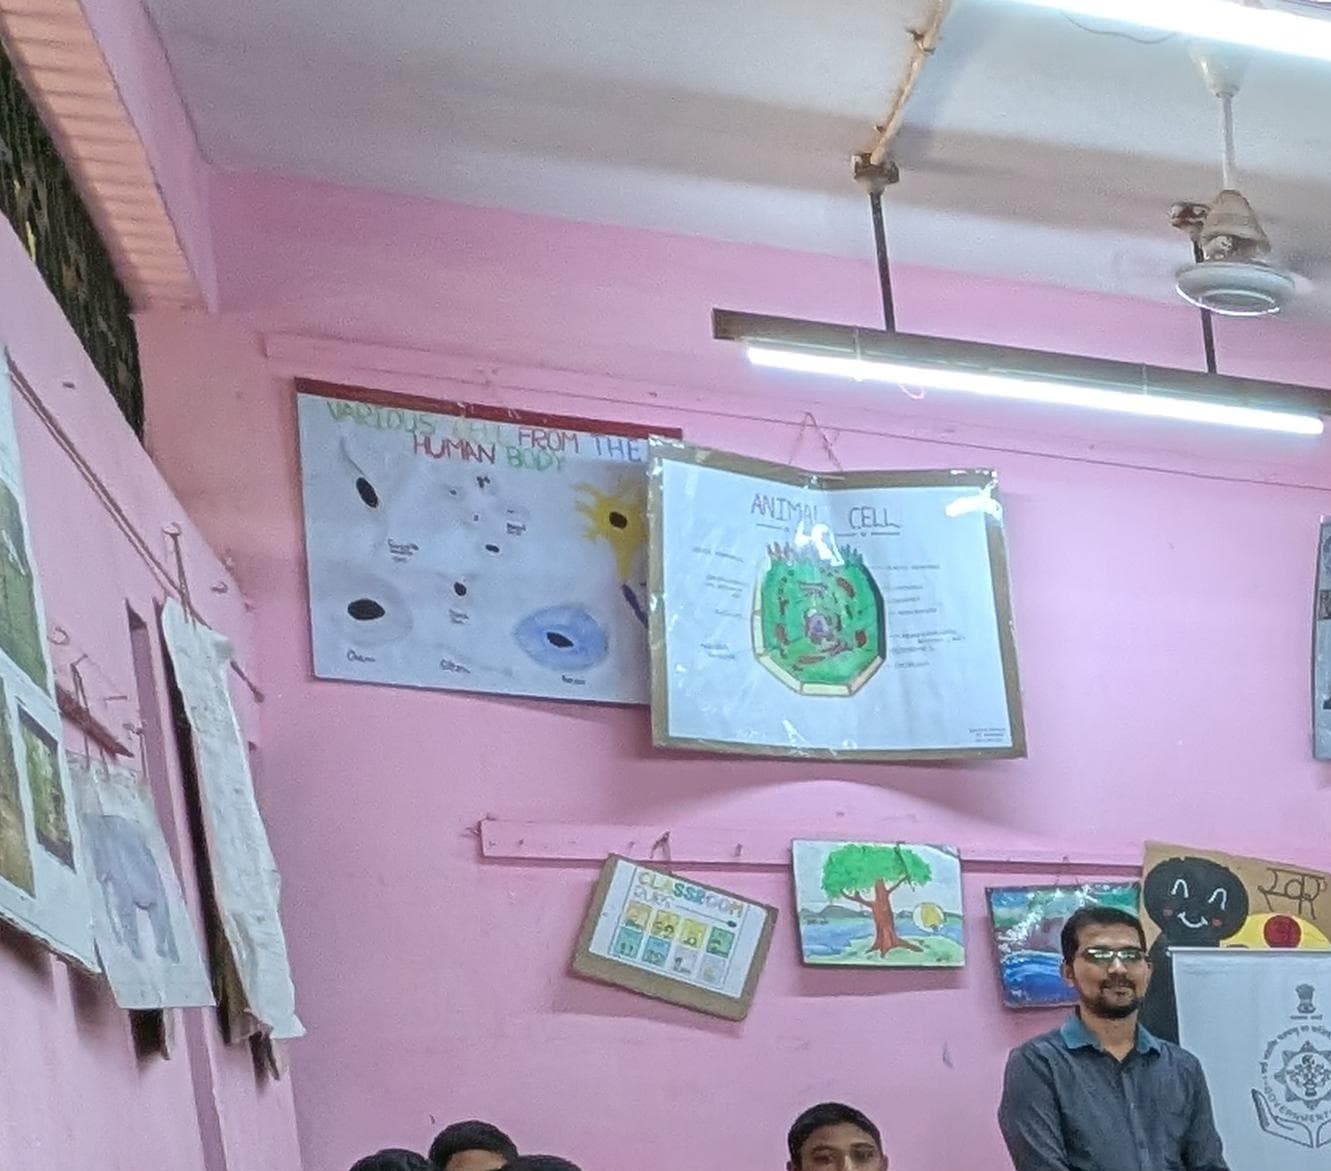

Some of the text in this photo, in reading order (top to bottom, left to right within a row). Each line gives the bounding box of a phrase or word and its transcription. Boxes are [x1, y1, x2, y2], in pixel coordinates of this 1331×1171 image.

[413, 430, 566, 472] HUMAN BODY
[518, 427, 579, 454] FROM
[591, 433, 643, 463] THE
[849, 506, 900, 530] CELL
